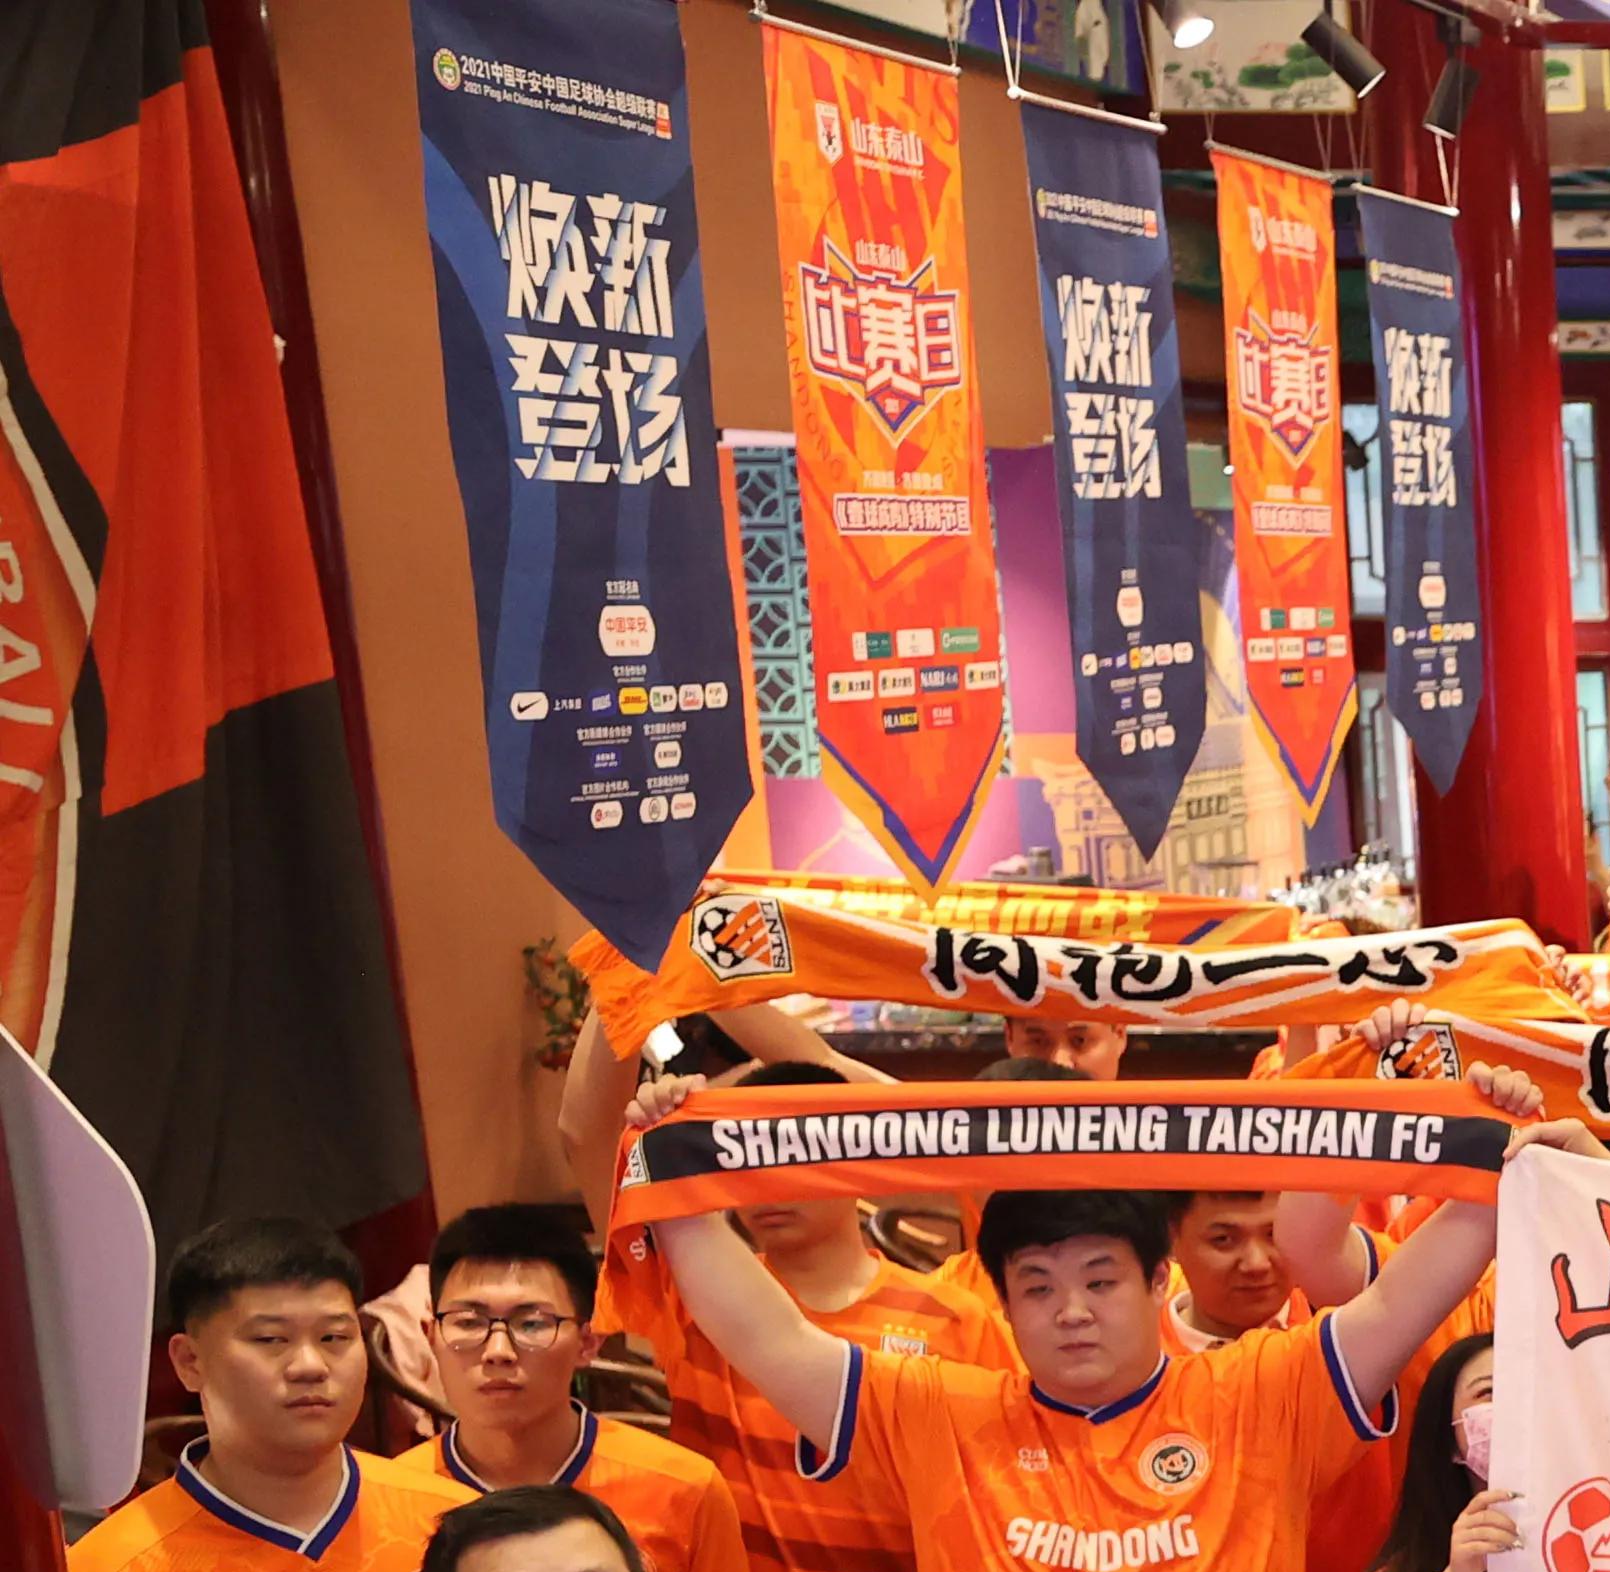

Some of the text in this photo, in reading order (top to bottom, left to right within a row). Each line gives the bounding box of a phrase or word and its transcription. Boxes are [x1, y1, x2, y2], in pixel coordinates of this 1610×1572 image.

[851, 117, 925, 166] 山东泰山
[488, 173, 673, 338] 焕新
[800, 272, 961, 397] 比赛日
[1056, 273, 1153, 387] 焕新
[1384, 326, 1453, 419] 焕新
[506, 332, 692, 487] 登场
[1064, 392, 1163, 499] 登场
[1389, 419, 1458, 508] 登场
[605, 616, 649, 633] 中国平安
[758, 901, 788, 972] LNTS
[1434, 1029, 1460, 1080] LNT
[711, 1103, 1446, 1171] SHANDONG LUNENG TAISHAN FC
[1005, 1512, 1200, 1572] SHANDONG
